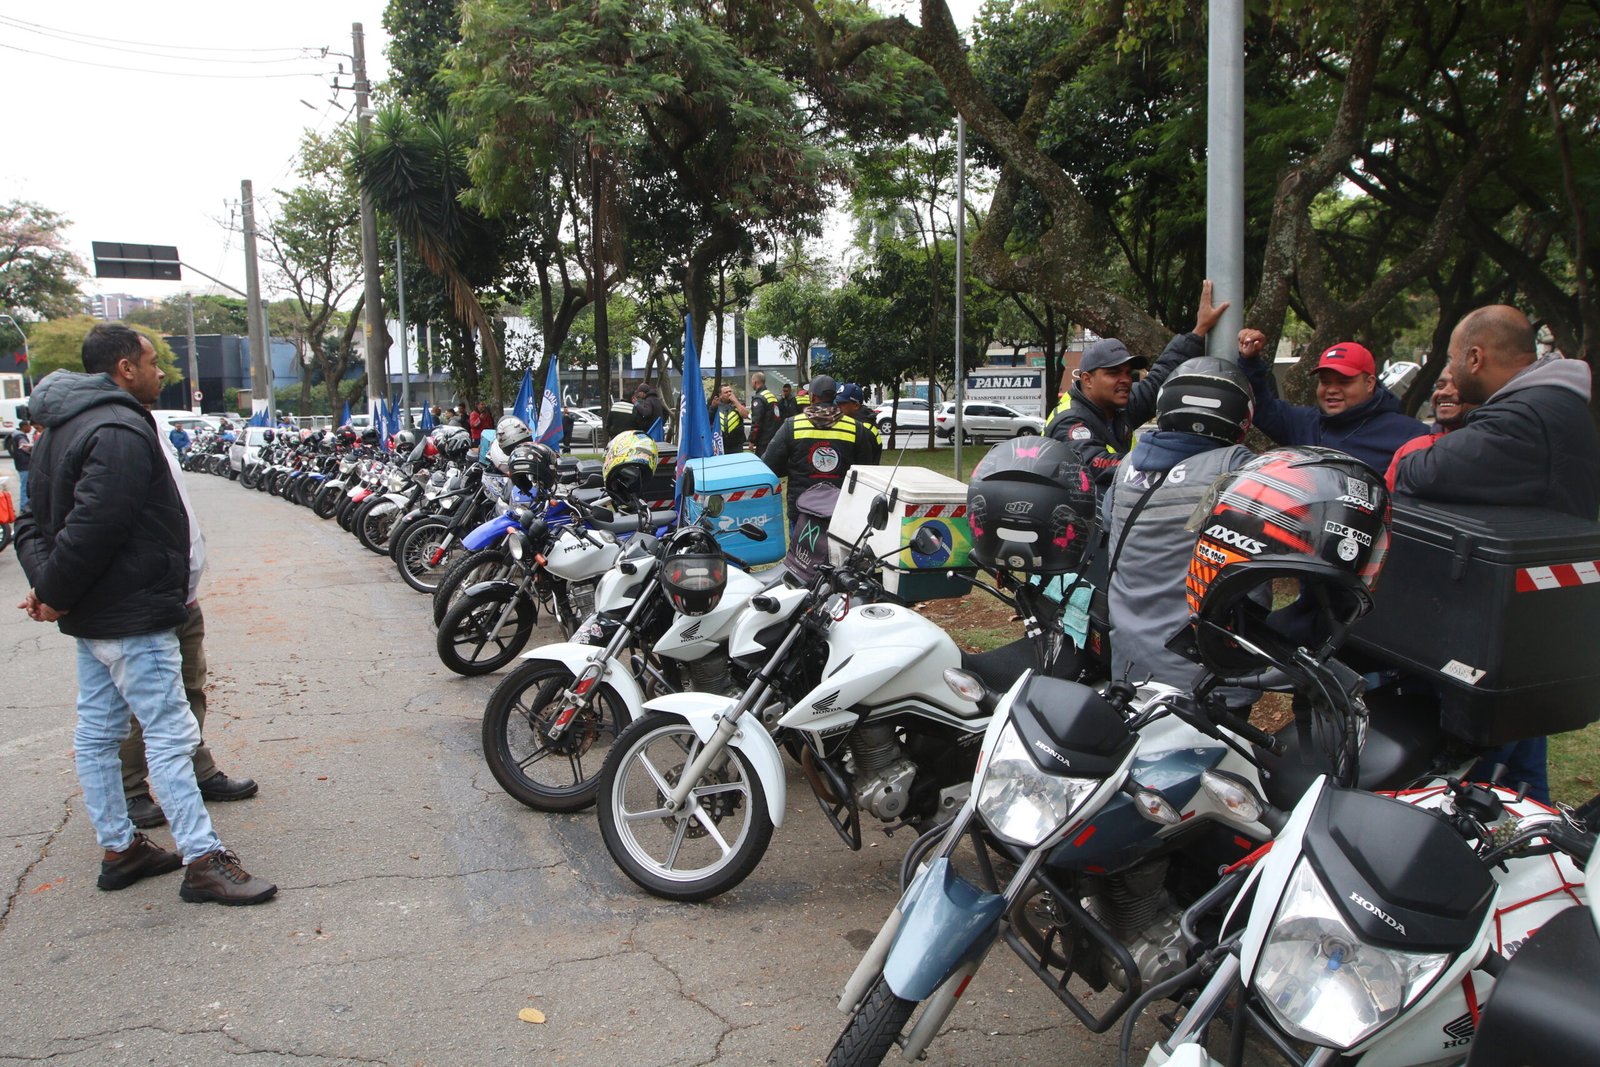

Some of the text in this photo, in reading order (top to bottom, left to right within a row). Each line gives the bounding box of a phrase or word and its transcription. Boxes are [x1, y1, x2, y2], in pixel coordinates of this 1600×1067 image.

[974, 377, 1033, 388] PANNAN
[1336, 495, 1375, 511] AXXIS
[1204, 524, 1268, 555] AXXIS
[1326, 522, 1371, 545] RDG 9060
[812, 706, 842, 715] HONDA
[1035, 740, 1071, 768] HONDA
[1349, 891, 1407, 936] HONDA
